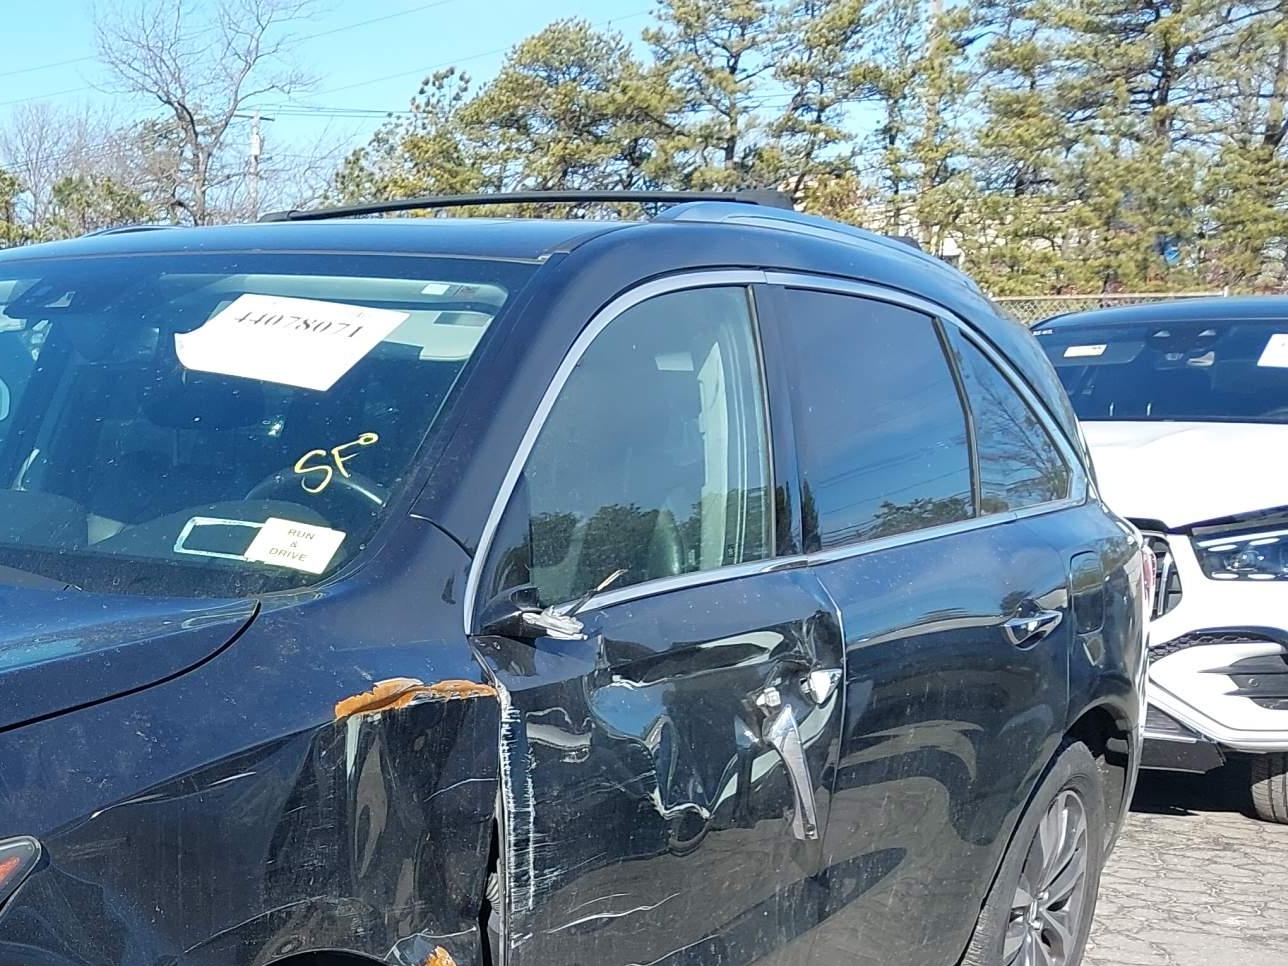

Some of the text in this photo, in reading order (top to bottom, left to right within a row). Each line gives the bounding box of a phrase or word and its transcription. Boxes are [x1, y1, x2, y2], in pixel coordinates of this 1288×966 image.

[234, 311, 364, 338] 44078071
[287, 527, 316, 541] RUN
[268, 547, 309, 562] DRIVE
